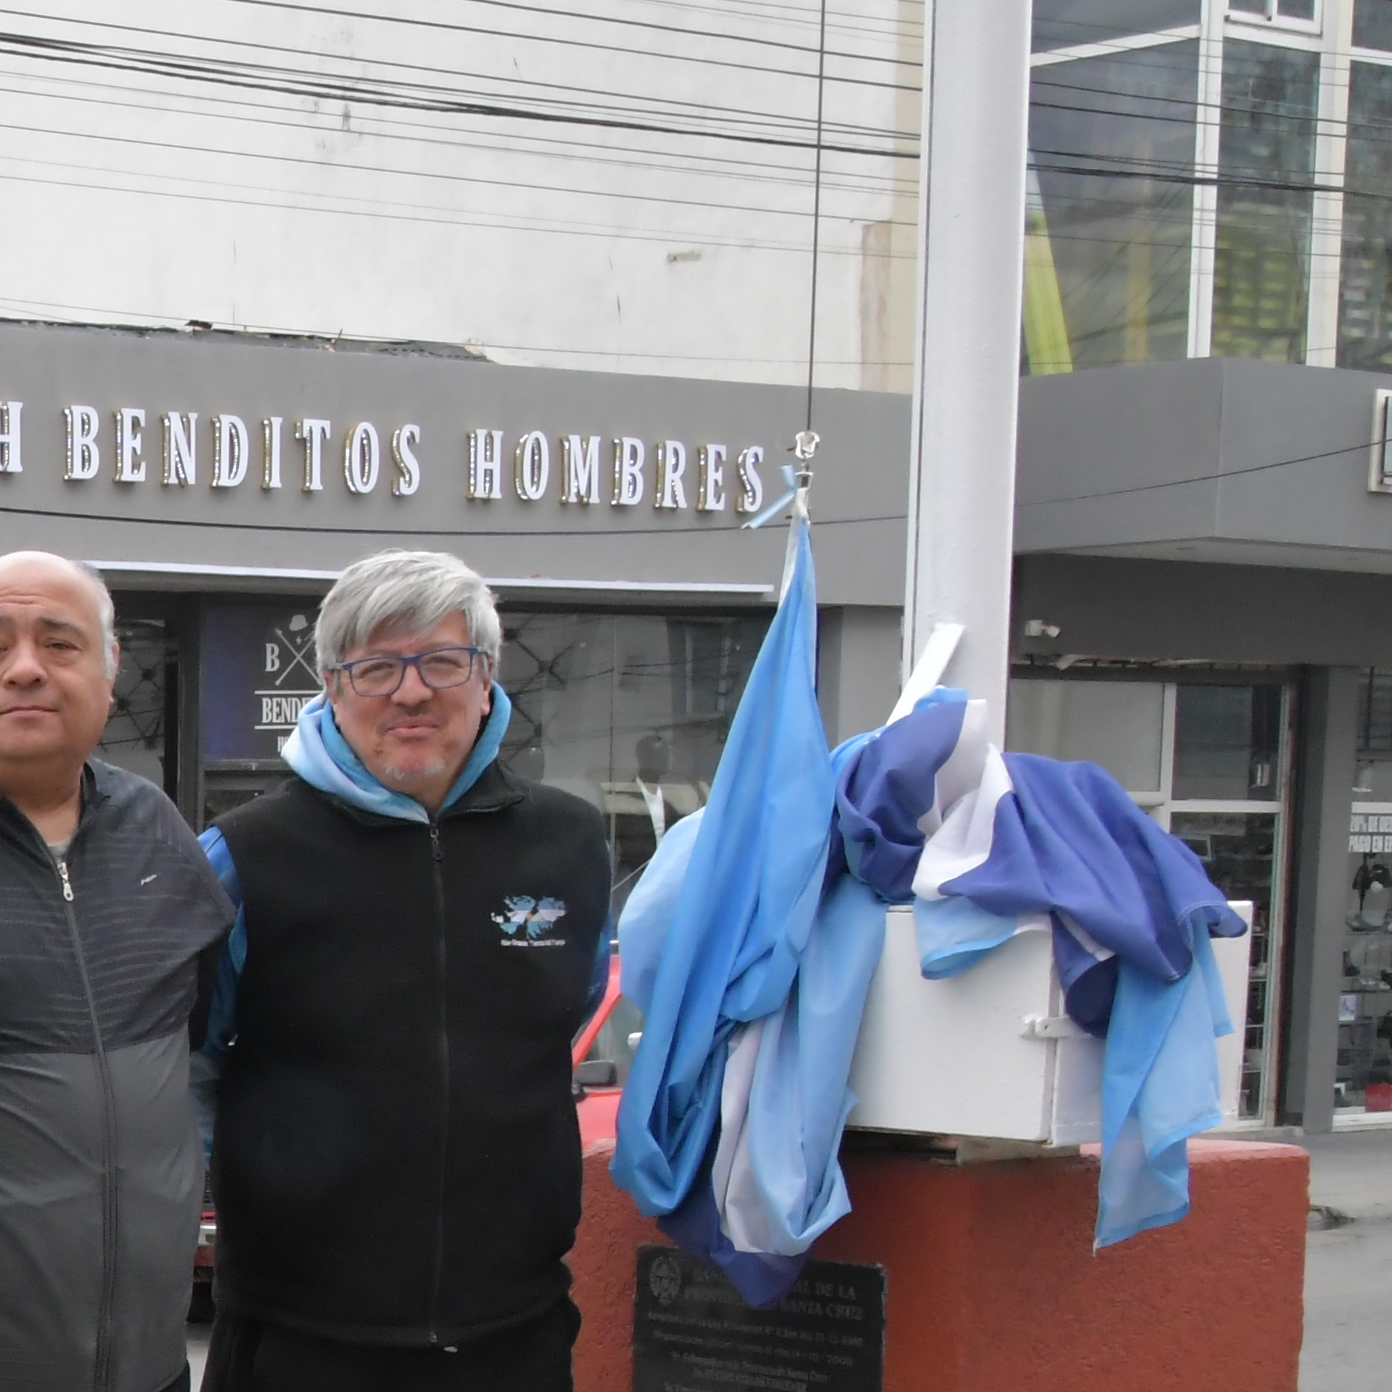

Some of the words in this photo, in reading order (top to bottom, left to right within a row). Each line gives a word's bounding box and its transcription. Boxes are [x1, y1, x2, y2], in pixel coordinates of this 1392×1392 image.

[64, 404, 421, 497] BENDITOS
[466, 428, 765, 514] HOMBRES
[262, 697, 313, 723] BEND
